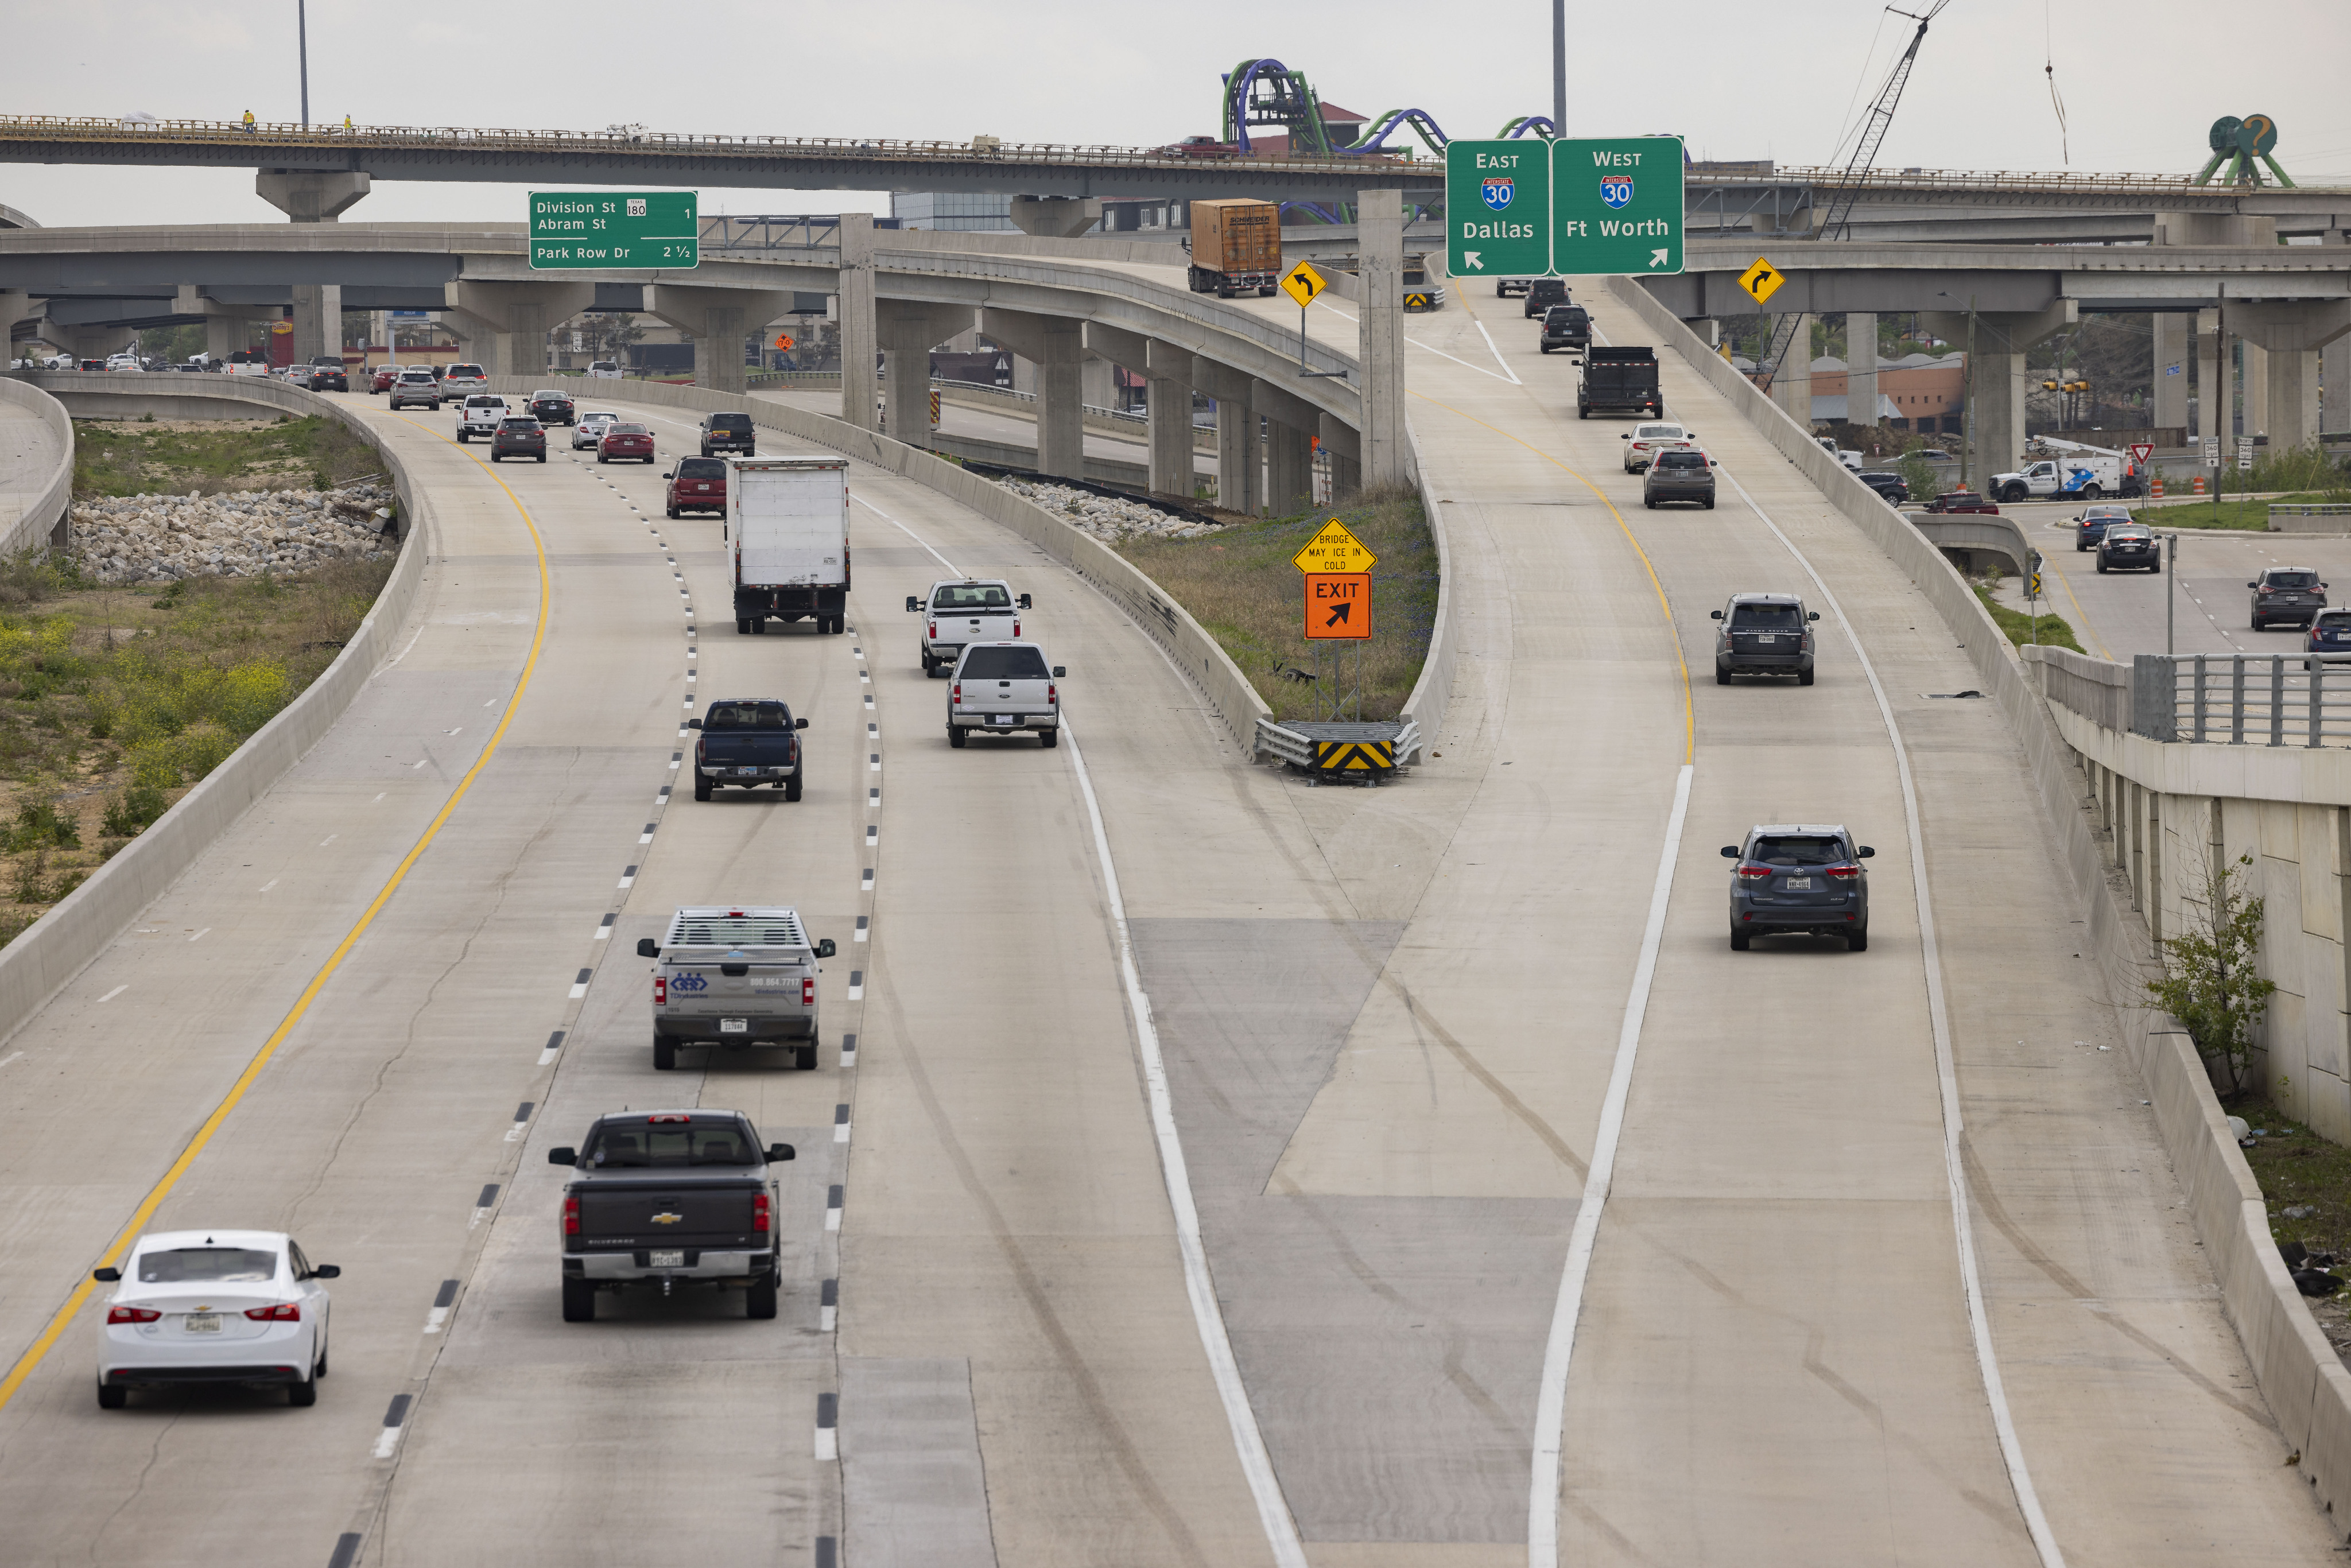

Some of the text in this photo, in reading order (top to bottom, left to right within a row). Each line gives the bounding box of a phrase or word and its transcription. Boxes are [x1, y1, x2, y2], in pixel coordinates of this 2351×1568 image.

[1476, 154, 1519, 168] EAST
[1593, 152, 1642, 166] WEST
[1486, 186, 1510, 203] 30
[1605, 184, 1630, 202] 30
[537, 201, 616, 214] Division St
[628, 205, 645, 215] 180
[685, 208, 690, 219] 1
[538, 218, 606, 230] Abram St
[1567, 218, 1669, 237] Ft Worth
[1464, 222, 1534, 239] Dallas
[537, 247, 630, 258] Park Row Dr
[1320, 535, 1349, 544] BRIDGE
[1309, 548, 1360, 557] MAY ICE IN
[1324, 561, 1346, 570] COLD
[1316, 583, 1359, 598] EXIT
[750, 978, 800, 986] 800.864.7717
